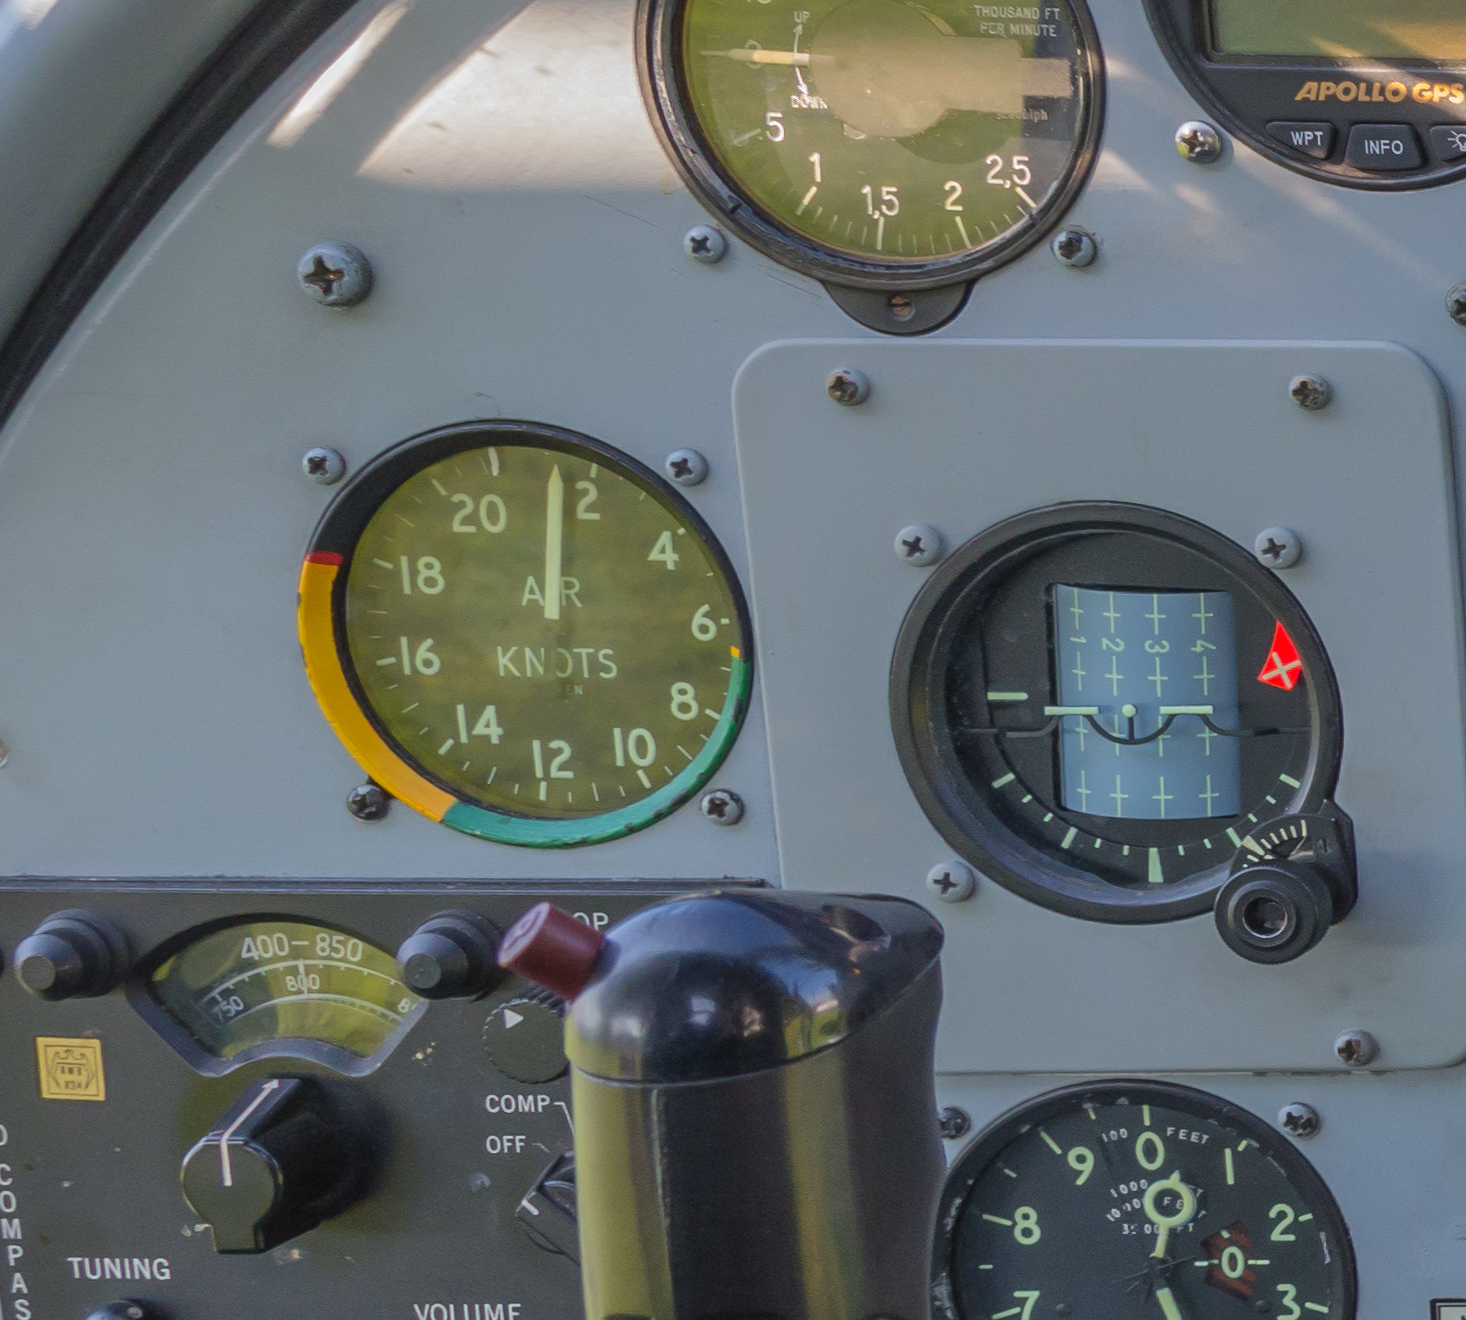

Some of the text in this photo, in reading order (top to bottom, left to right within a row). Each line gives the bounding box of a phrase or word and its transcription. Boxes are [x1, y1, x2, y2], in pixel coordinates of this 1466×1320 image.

[1295, 81, 1465, 104] APOLLO GPS
[1291, 131, 1323, 146] WPT
[1364, 139, 1403, 155] INFO
[452, 494, 507, 533] 20
[400, 555, 445, 595] 18
[456, 704, 503, 744] 14
[532, 739, 574, 779] 12
[613, 727, 657, 768] 10
[485, 1094, 551, 1114] COMP
[486, 1136, 526, 1153] OFF
[67, 1257, 171, 1281] TUNING
